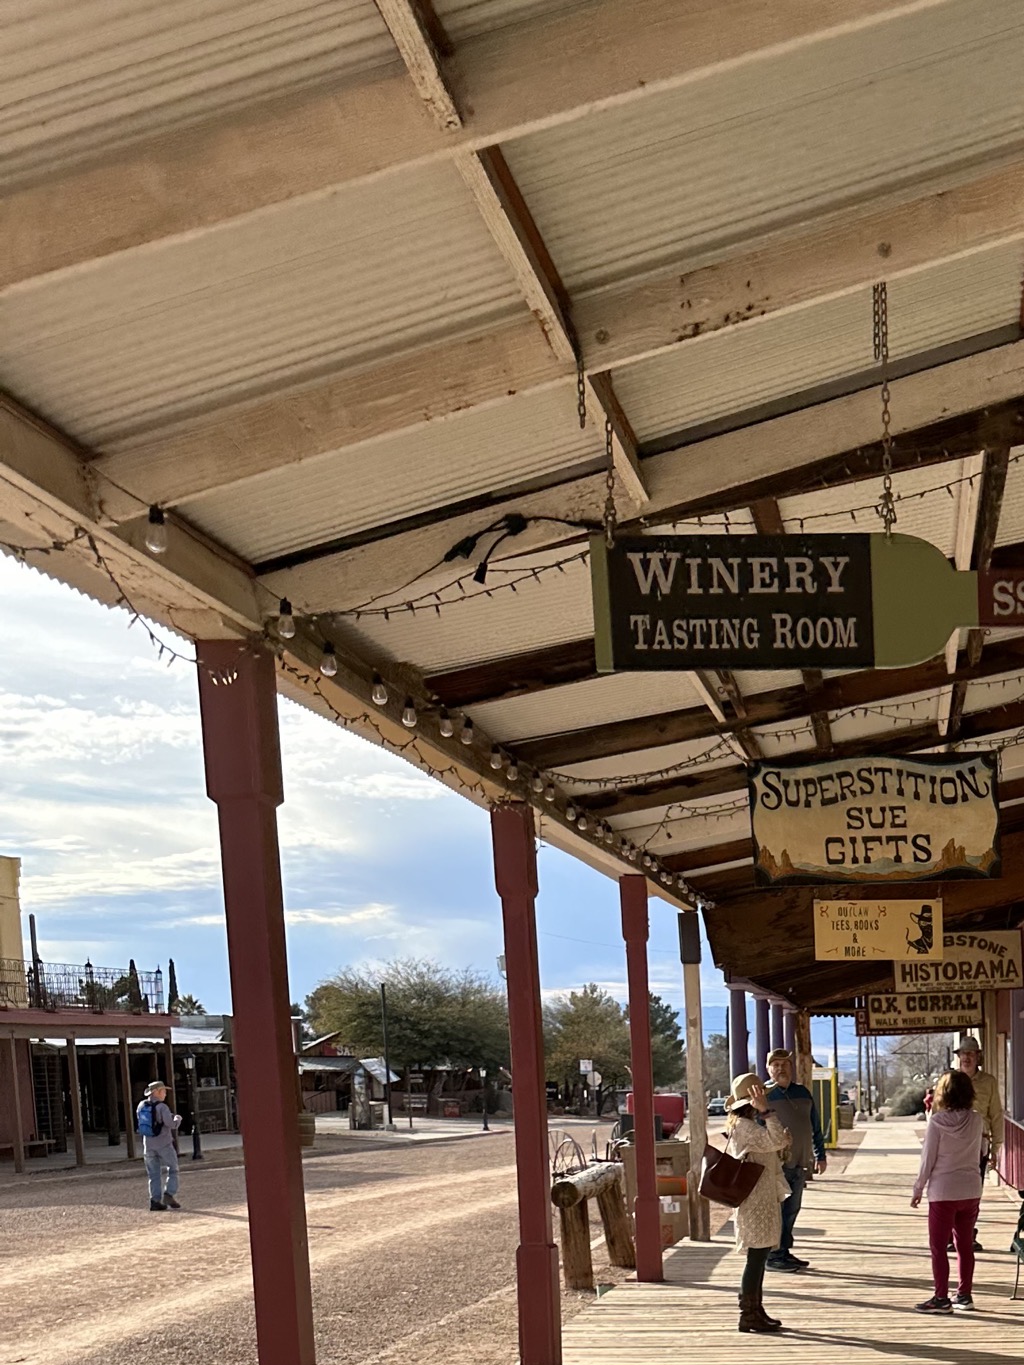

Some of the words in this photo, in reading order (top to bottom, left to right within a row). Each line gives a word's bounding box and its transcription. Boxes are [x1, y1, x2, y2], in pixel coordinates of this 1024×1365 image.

[626, 552, 850, 595] WINERY
[629, 614, 761, 650] TASTING
[771, 613, 858, 649] ROOM
[760, 766, 990, 811] SUPERSTITION
[846, 806, 908, 830] SUE
[824, 834, 932, 865] GIFTS
[854, 919, 880, 931] BOOKS
[852, 932, 859, 944] &
[844, 946, 867, 957] MORE
[900, 958, 1020, 983] HISTORAMA
[870, 996, 902, 1015] O.K.
[906, 993, 978, 1012] CORRAL
[875, 1018, 899, 1026] WALK
[932, 1016, 953, 1024] THEY
